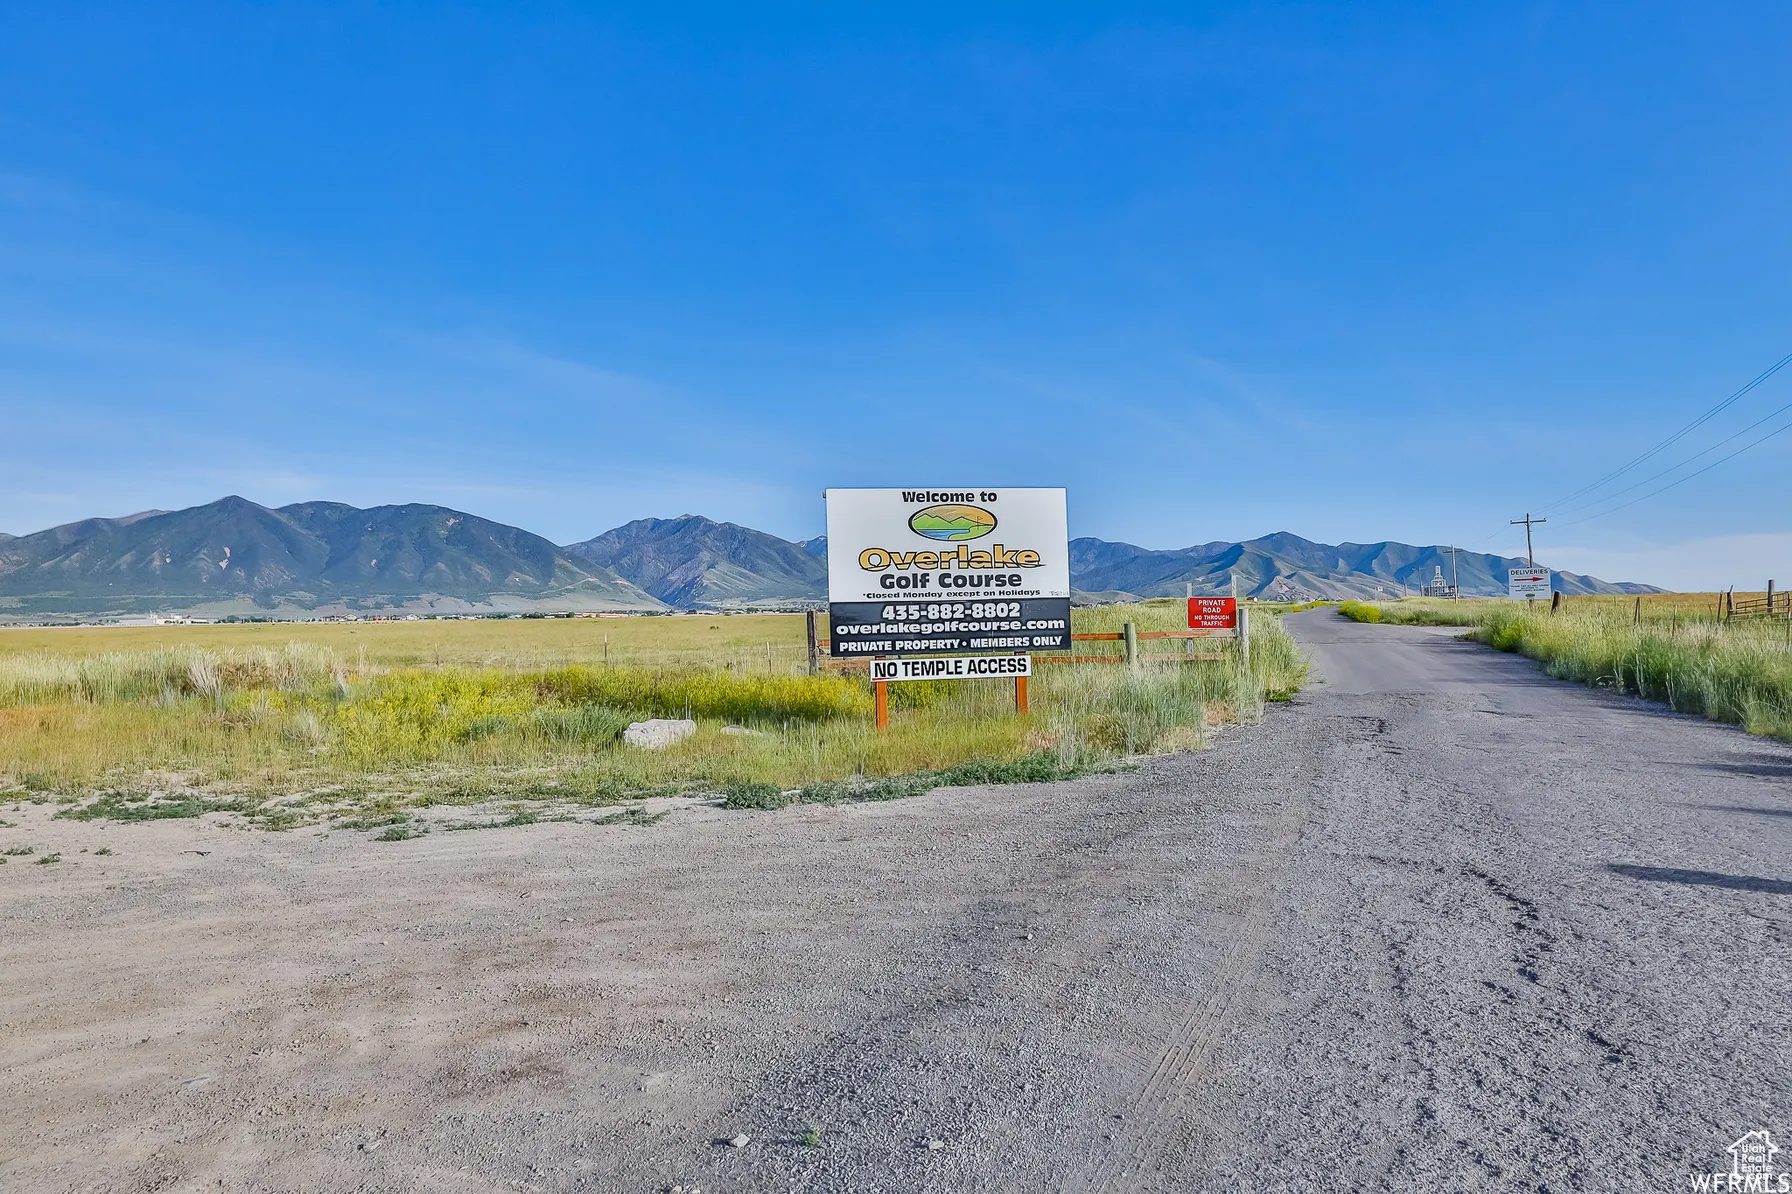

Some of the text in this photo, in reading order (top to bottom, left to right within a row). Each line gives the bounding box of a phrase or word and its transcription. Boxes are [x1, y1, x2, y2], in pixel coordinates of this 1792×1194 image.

[902, 491, 997, 502] Welcome to
[858, 544, 1046, 571] Overlake
[880, 573, 1022, 589] Golf Course
[903, 591, 942, 599] Monday
[946, 589, 980, 598] except
[998, 589, 1041, 597] Holidays
[882, 602, 1021, 620] 435-882-8802
[836, 619, 1065, 635] overlakegolfcourse.com
[839, 636, 1062, 652] PRIVATE PROPERTY MEMBERS ONLY
[874, 657, 1027, 677] NO TEMPLE ACCESS
